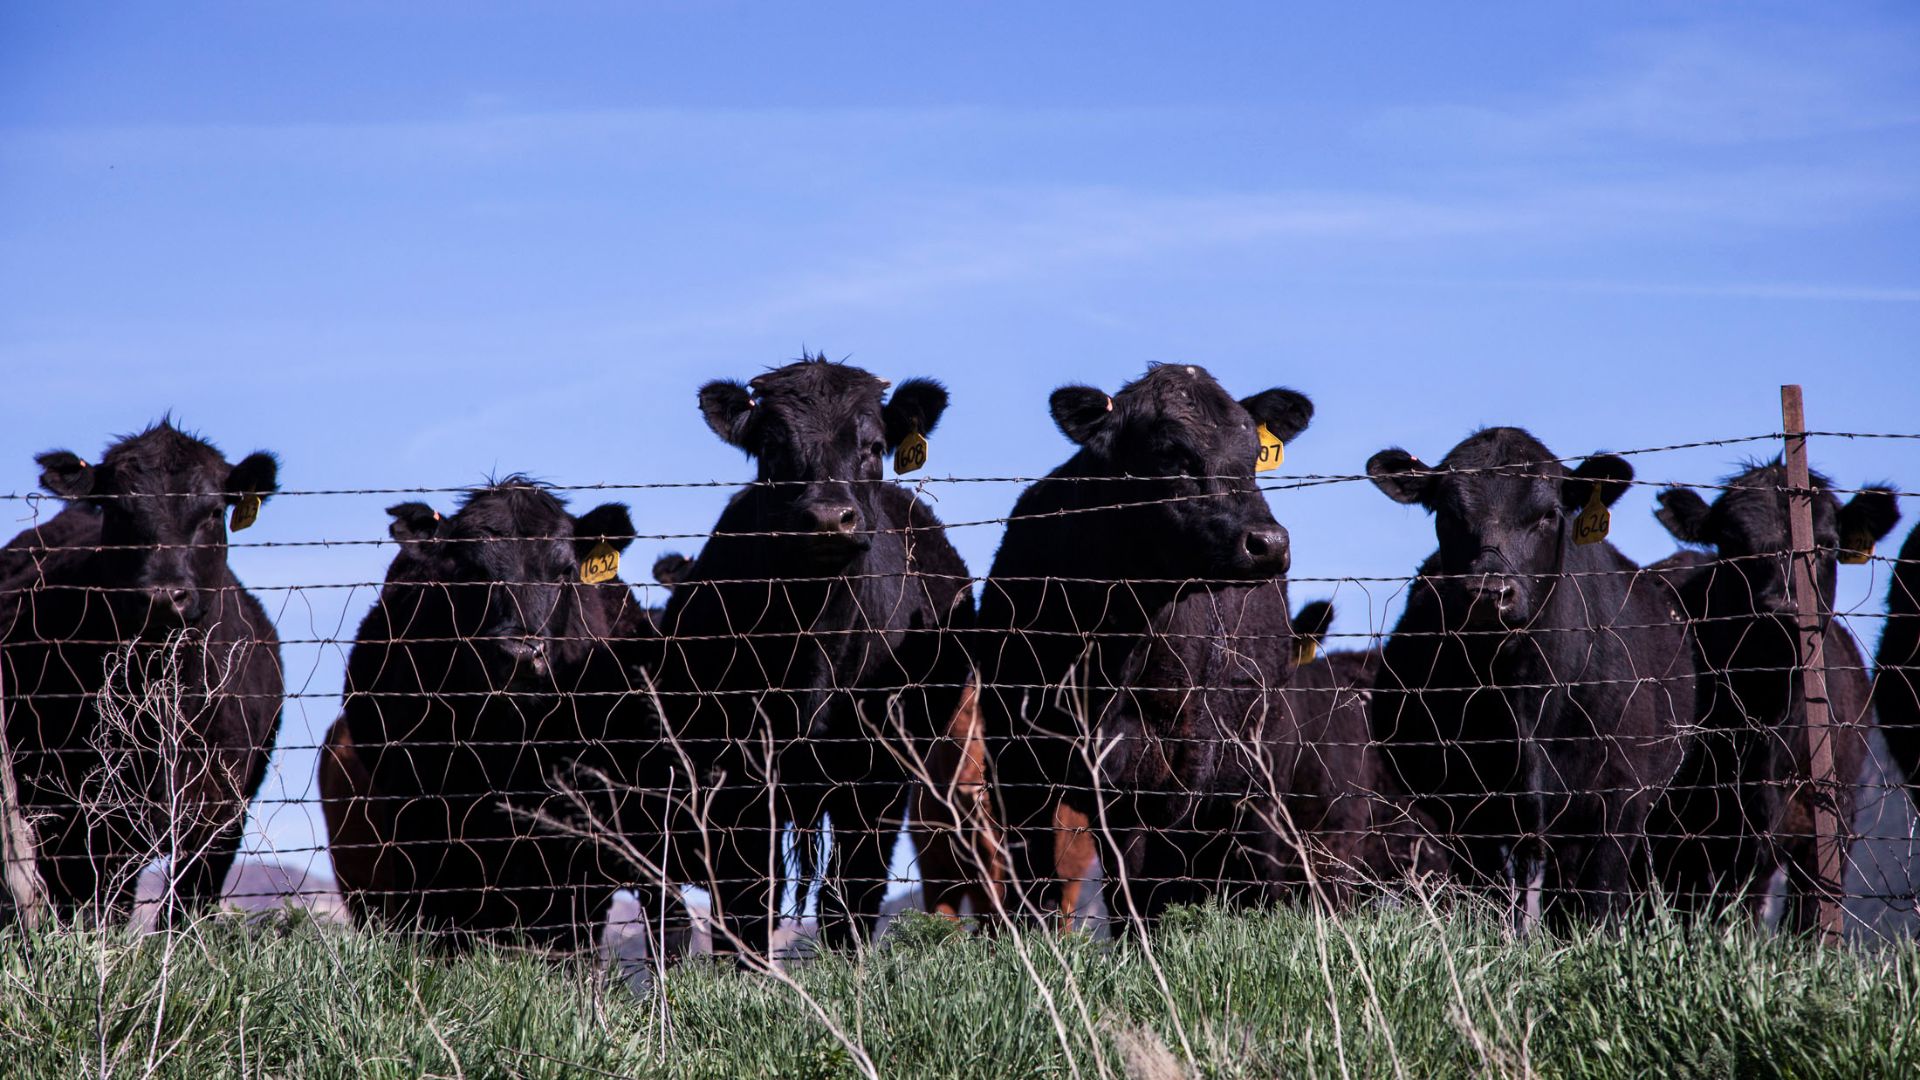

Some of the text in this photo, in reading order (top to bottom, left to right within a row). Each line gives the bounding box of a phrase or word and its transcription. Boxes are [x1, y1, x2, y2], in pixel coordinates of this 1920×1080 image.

[896, 443, 924, 470] 1608
[1575, 513, 1608, 539] 1626
[583, 552, 618, 578] 1632
